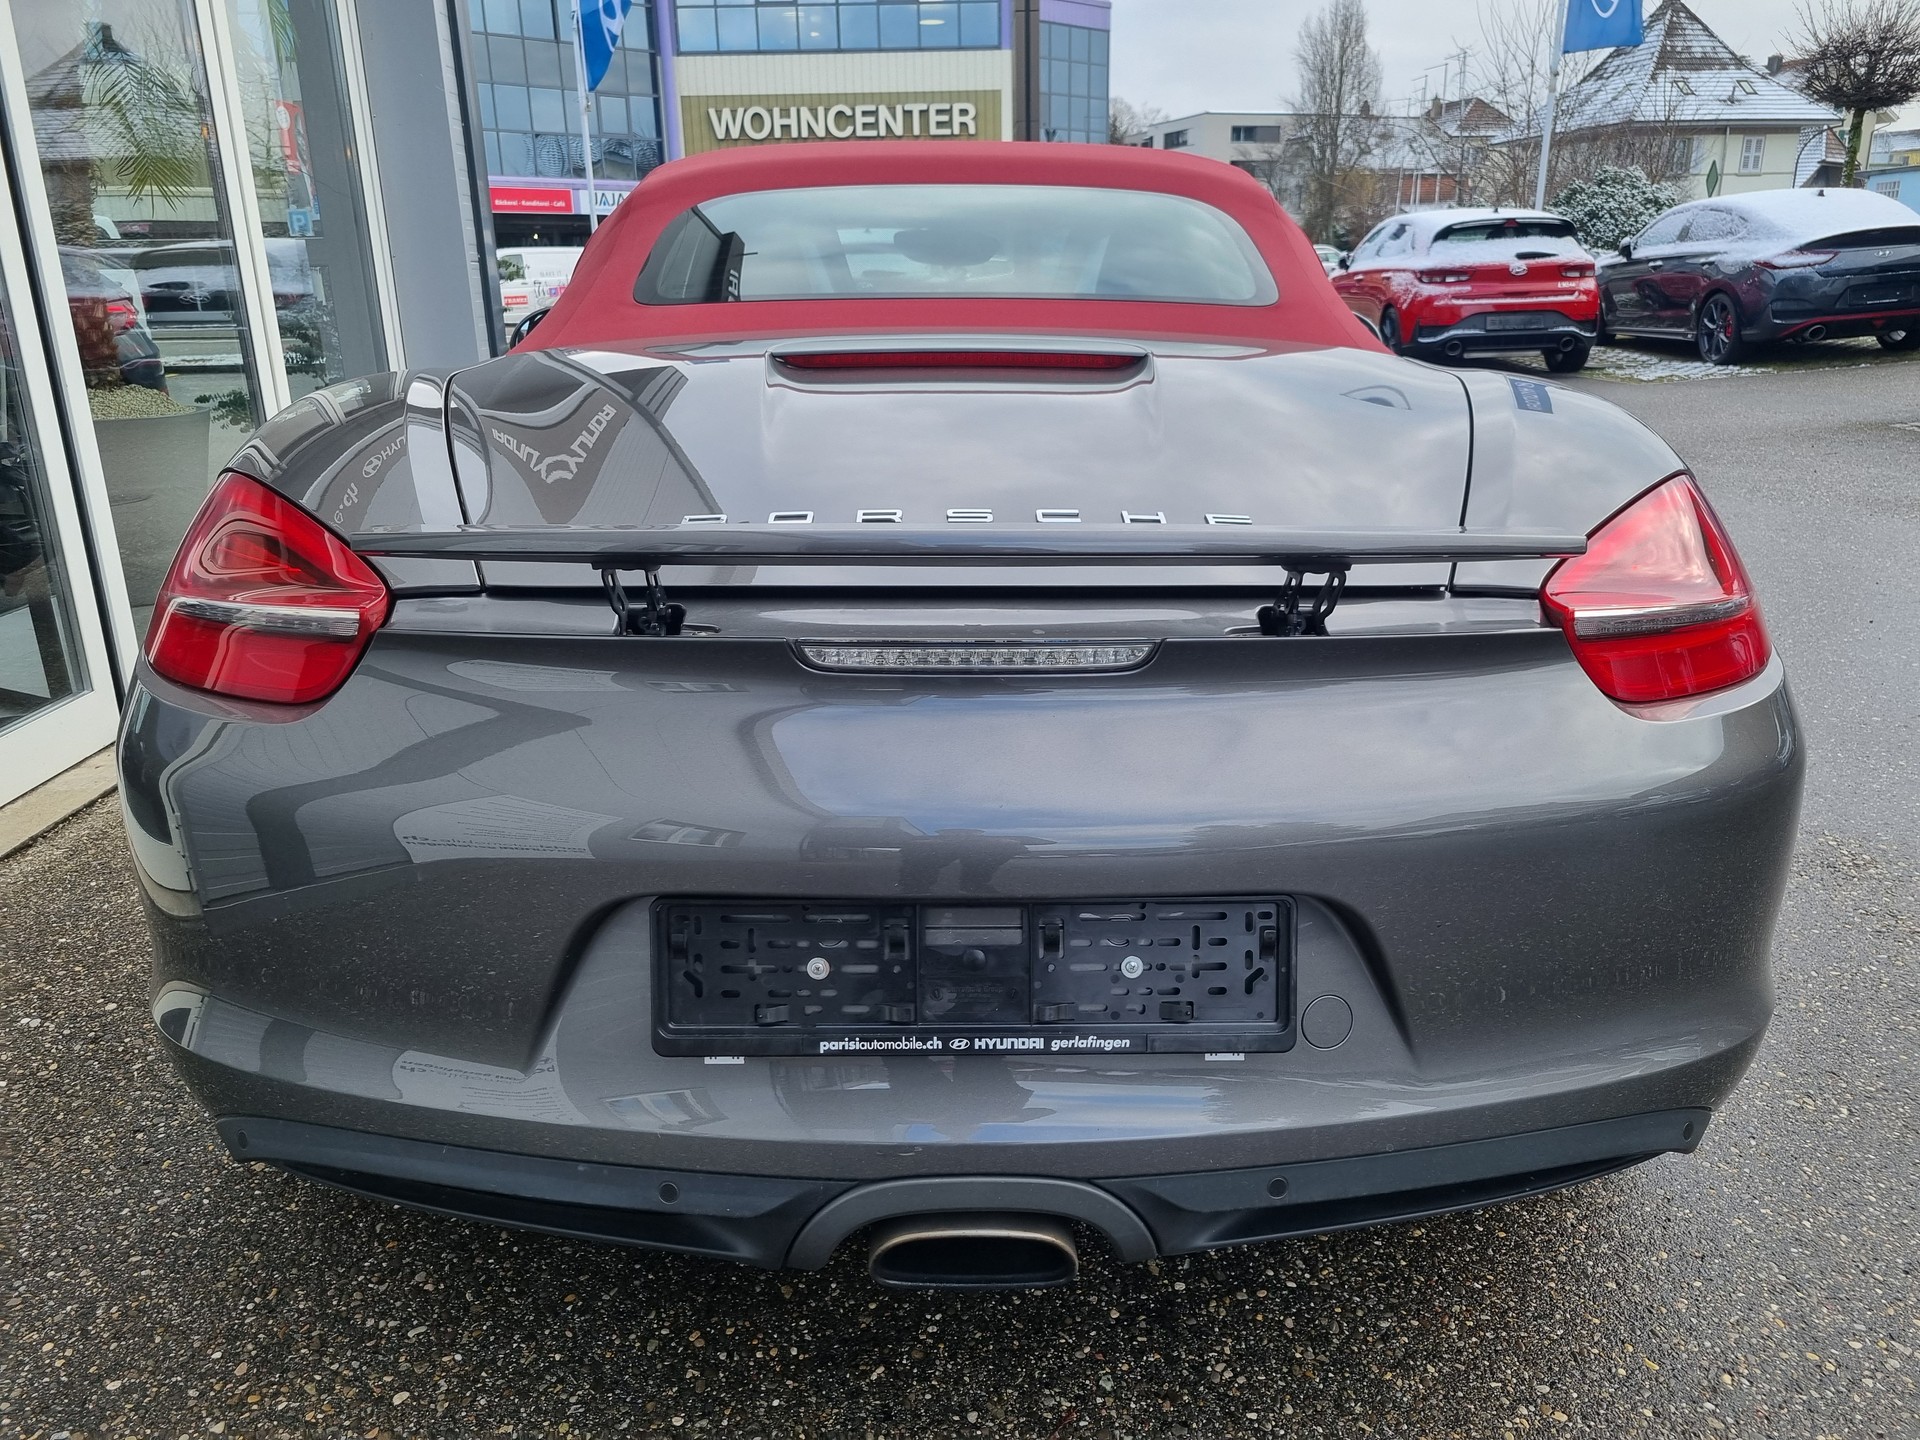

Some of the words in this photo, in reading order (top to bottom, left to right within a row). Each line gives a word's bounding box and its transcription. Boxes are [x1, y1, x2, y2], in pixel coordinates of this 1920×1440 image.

[708, 102, 977, 140] WOHNCENTER
[682, 508, 1253, 525] PORSCHE
[819, 1036, 943, 1053] parisiautomobile.ch
[974, 1038, 1044, 1050] HYUNDAI
[1050, 1035, 1131, 1052] gerlafingen
